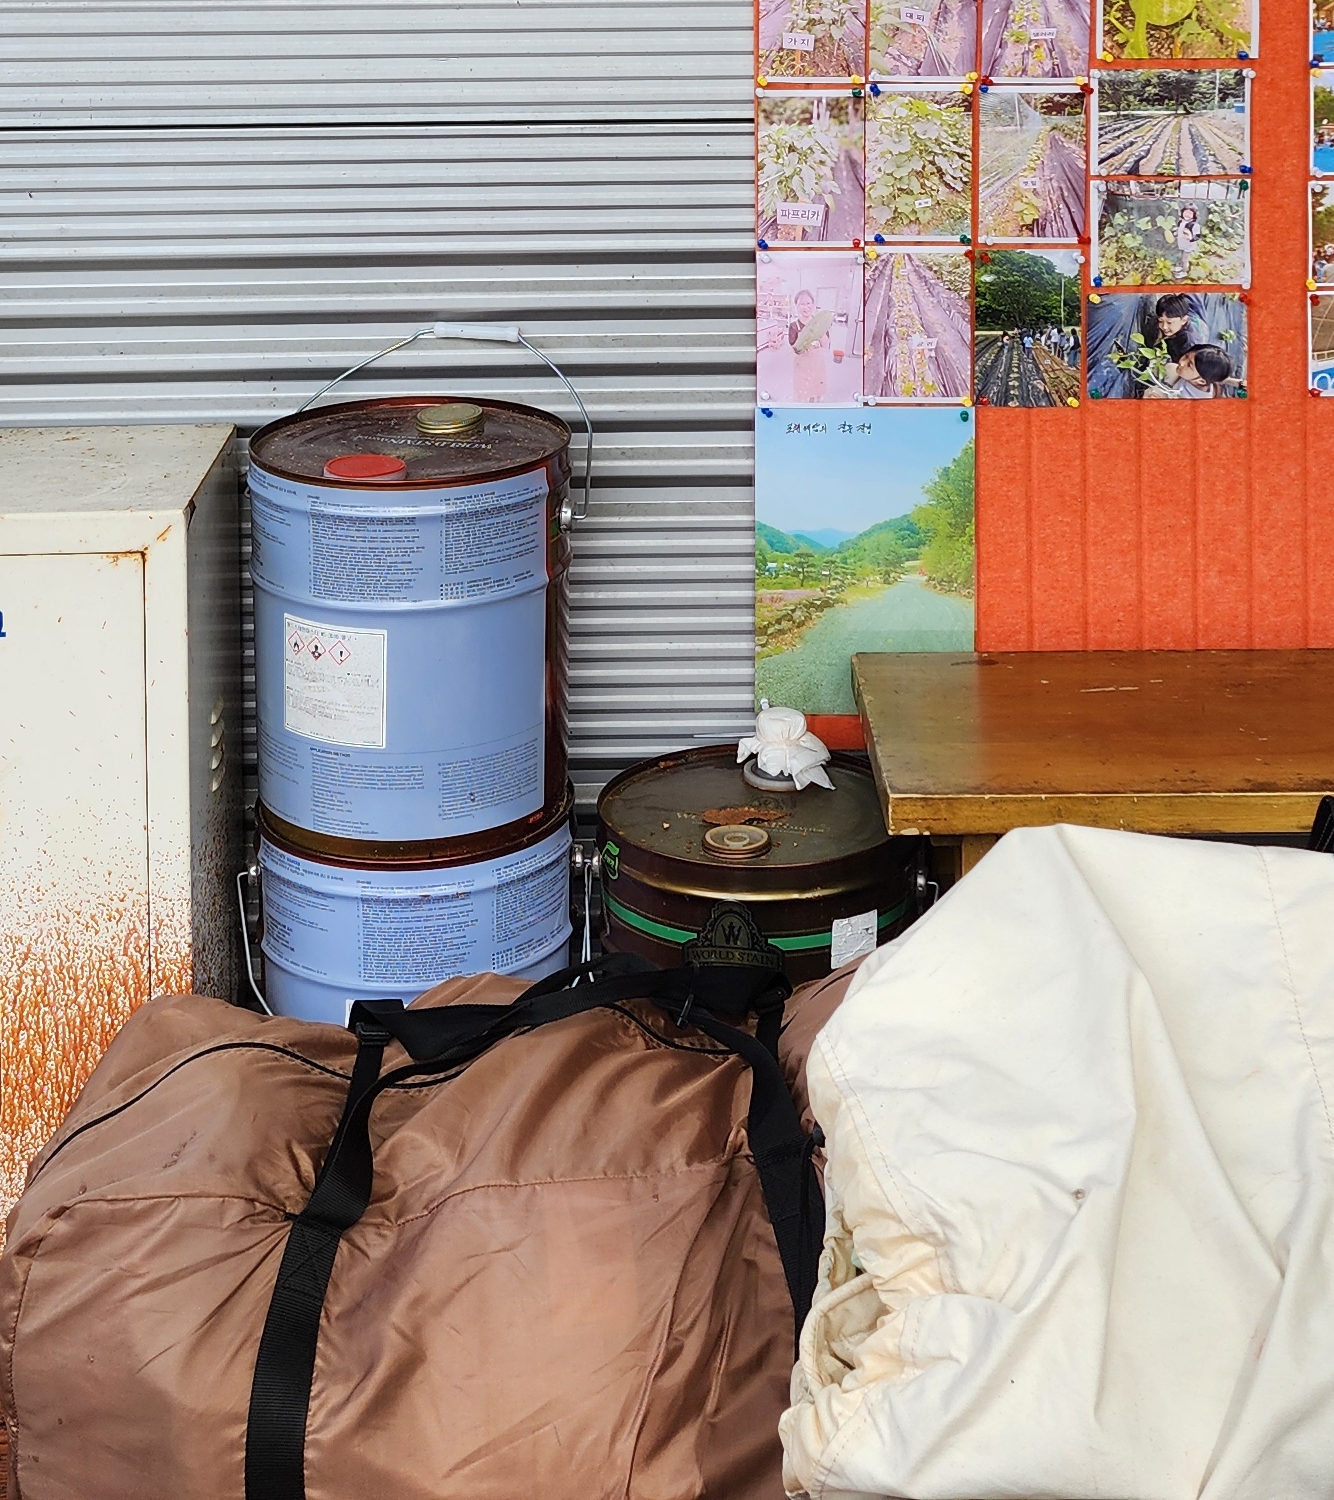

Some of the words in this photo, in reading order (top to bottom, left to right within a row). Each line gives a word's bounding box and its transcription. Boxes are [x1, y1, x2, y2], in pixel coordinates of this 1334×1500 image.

[786, 36, 811, 48] 가지
[779, 208, 820, 222] 파프리카
[691, 948, 735, 961] WORLD
[737, 951, 774, 965] STAIN
